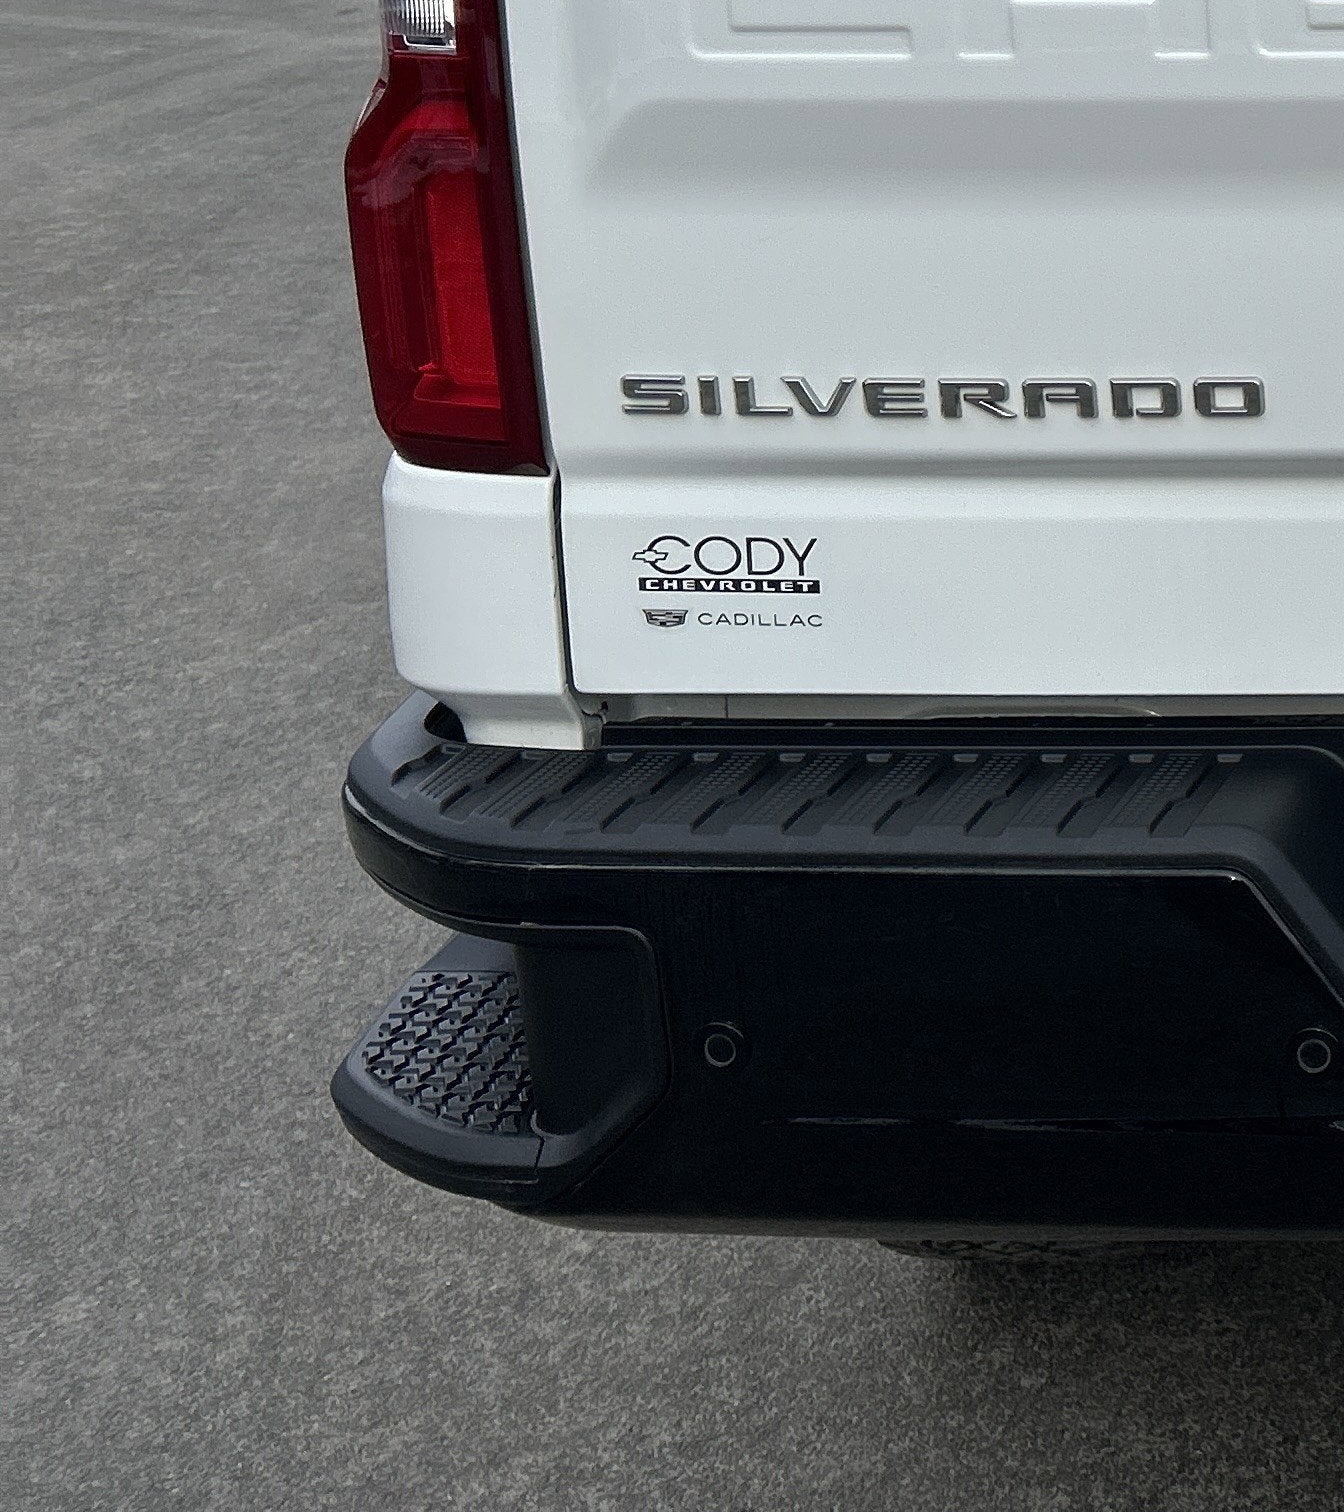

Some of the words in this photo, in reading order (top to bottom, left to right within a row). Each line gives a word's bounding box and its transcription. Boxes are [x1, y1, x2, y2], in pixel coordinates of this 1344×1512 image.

[620, 374, 1266, 418] SILVERADO
[640, 535, 818, 576] CODY
[644, 579, 814, 593] CHEVROLET
[697, 612, 823, 627] CADILLAC
